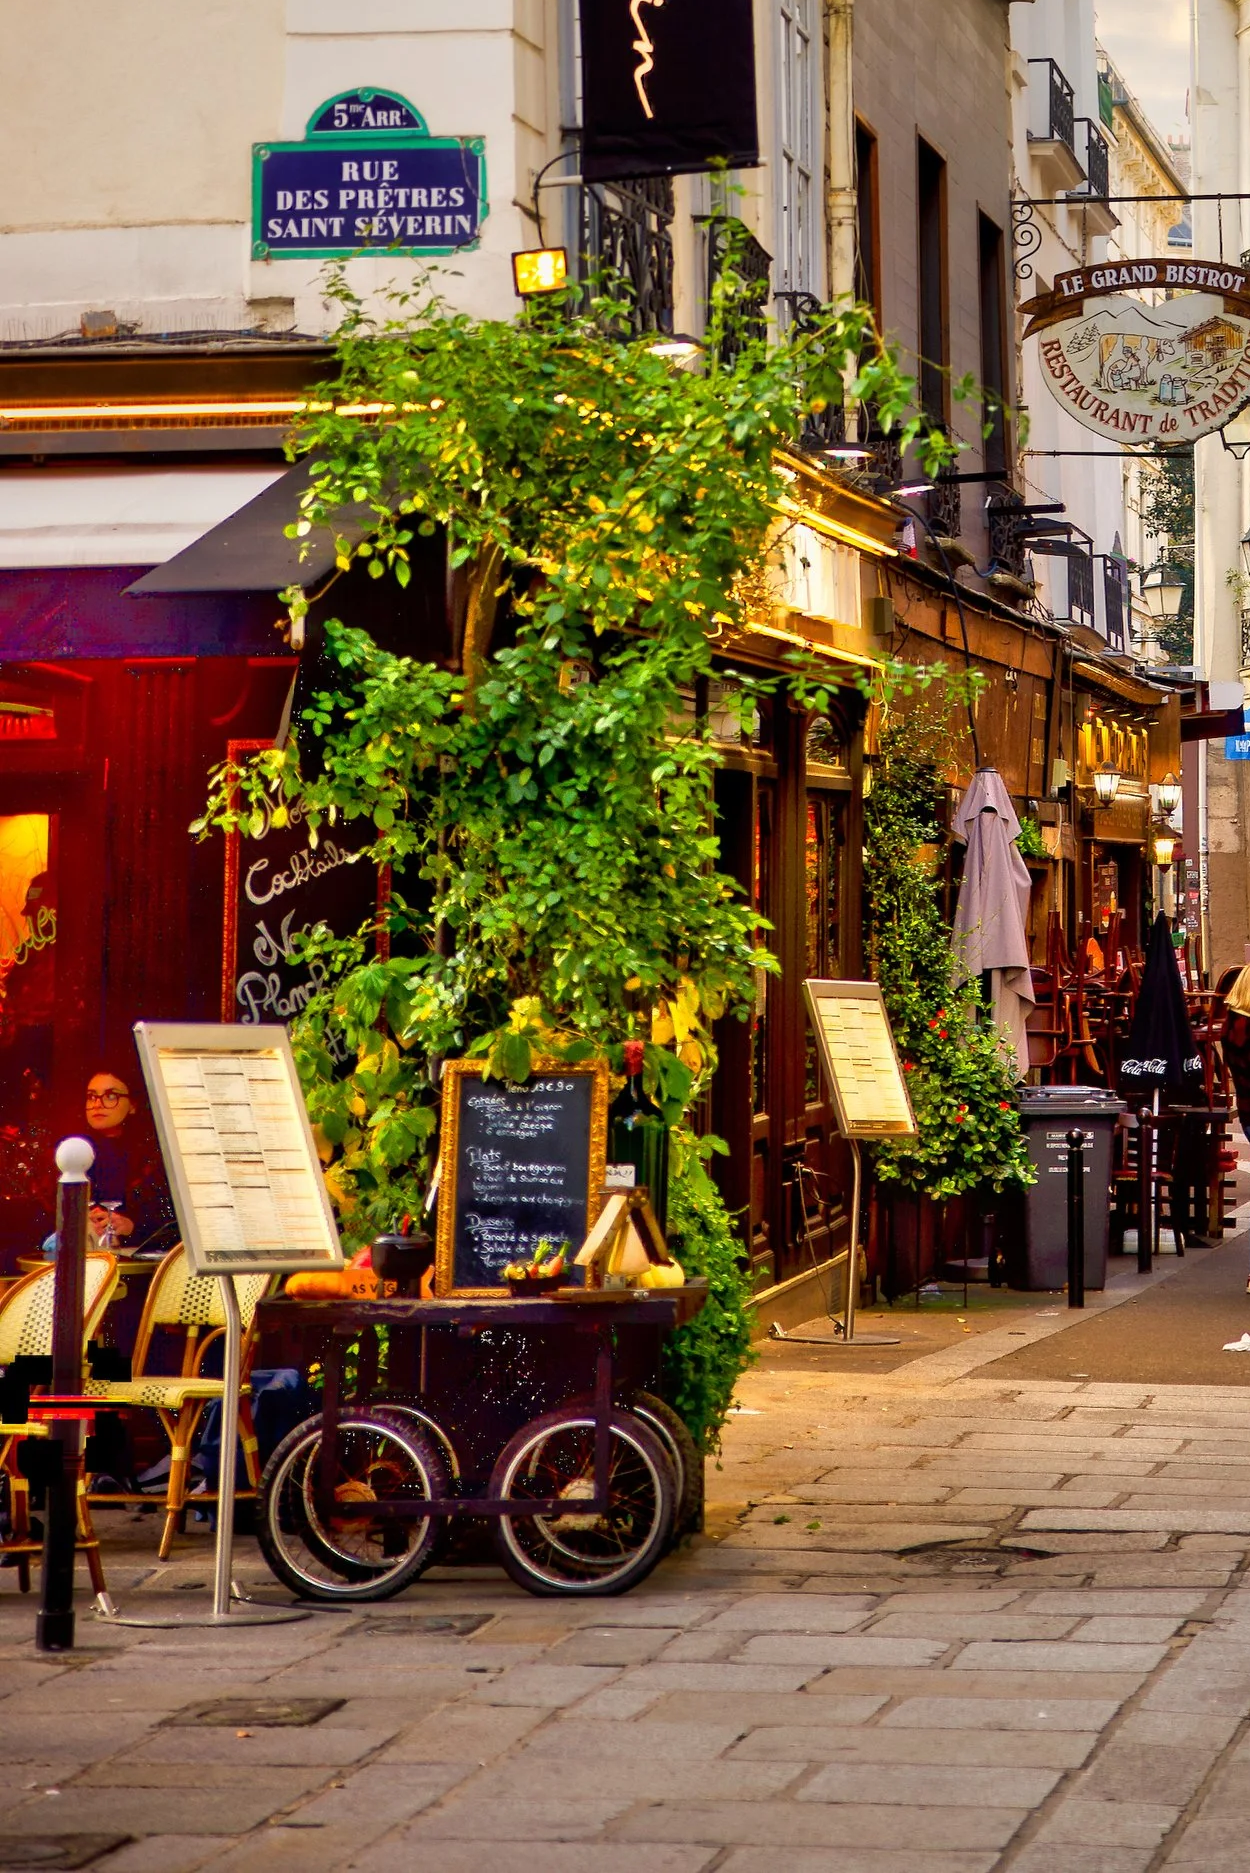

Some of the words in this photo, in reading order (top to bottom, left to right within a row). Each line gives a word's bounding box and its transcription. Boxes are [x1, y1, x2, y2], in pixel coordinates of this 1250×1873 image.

[342, 161, 398, 181] RUE
[276, 190, 329, 211] DES
[339, 182, 464, 210] PRÊTRES
[268, 218, 345, 238] SAINT
[355, 209, 472, 238] SÉVERIN
[1060, 277, 1085, 296] LE
[1091, 265, 1157, 289] GRAND
[1165, 264, 1246, 293] BISTROT
[1040, 337, 1153, 434] RESTAURANT
[1159, 413, 1179, 433] de
[245, 840, 353, 905] Cocktails
[466, 1146, 501, 1162] Plats
